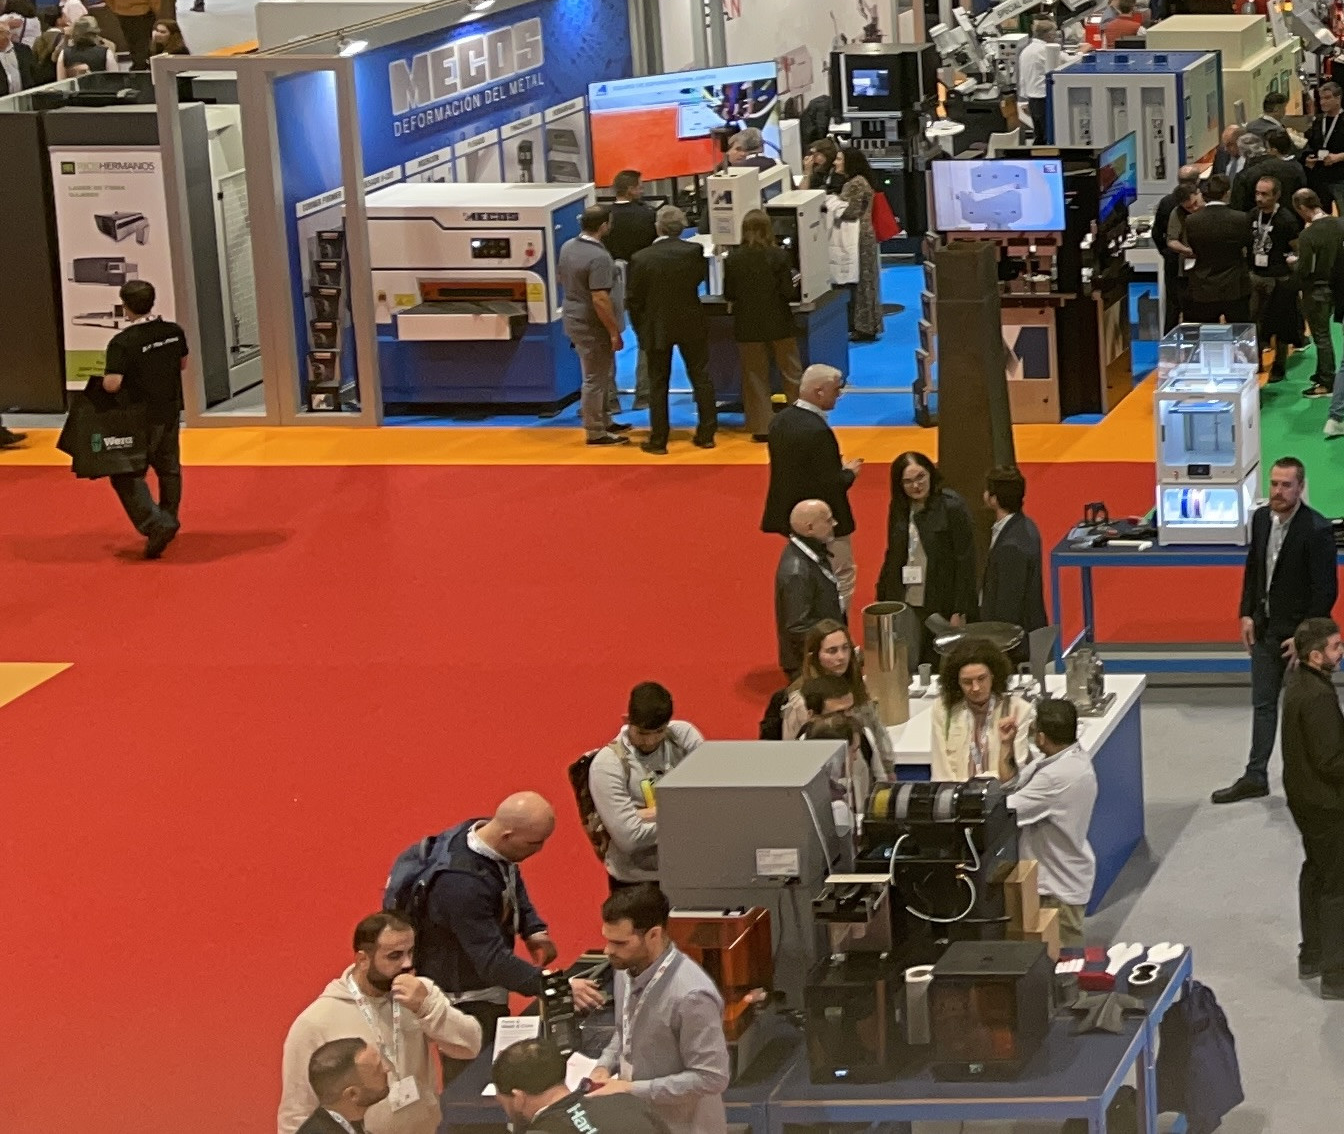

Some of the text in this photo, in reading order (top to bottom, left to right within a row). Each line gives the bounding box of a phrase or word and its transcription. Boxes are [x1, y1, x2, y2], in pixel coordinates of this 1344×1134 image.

[388, 16, 545, 116] MECOS
[393, 72, 545, 137] DEFORMACIÓN DEL METAL
